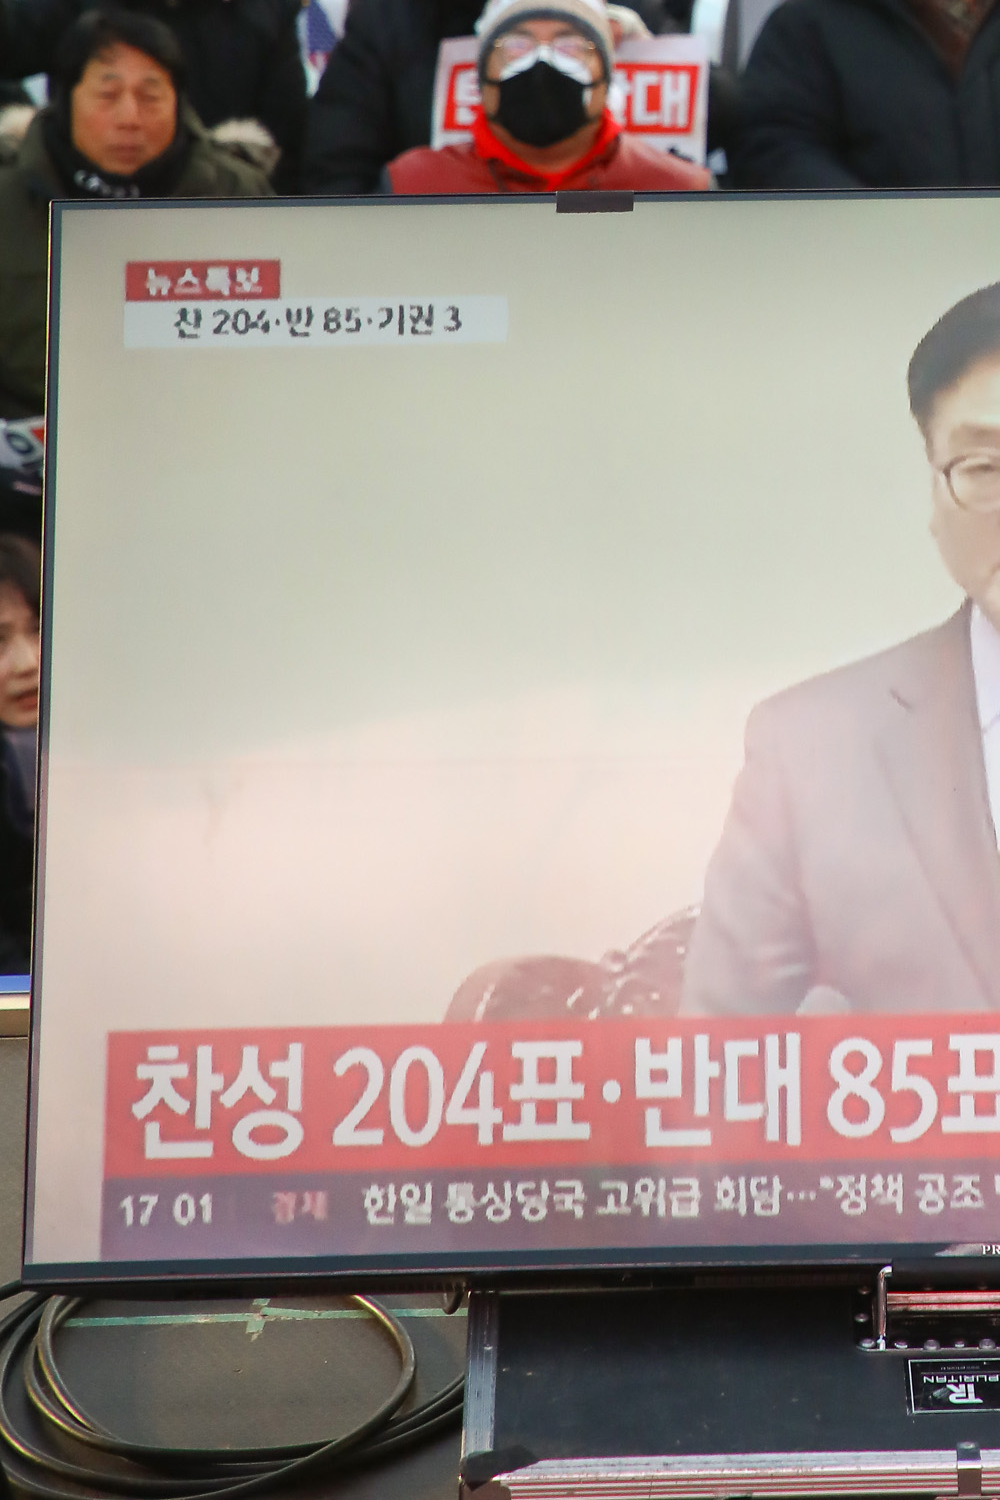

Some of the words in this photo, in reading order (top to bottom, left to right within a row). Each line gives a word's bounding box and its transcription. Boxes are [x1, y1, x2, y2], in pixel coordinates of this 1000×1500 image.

[145, 266, 263, 297] 뉴스특보
[173, 306, 202, 339] 찬
[443, 304, 463, 333] 3
[131, 1042, 305, 1161] 찬성
[120, 1193, 158, 1227] 17
[171, 1192, 214, 1225] 01
[362, 1181, 433, 1226] 한일
[445, 1178, 586, 1225] 통상당국
[597, 1176, 701, 1218] 고위급
[917, 1171, 985, 1215] 공조
[923, 1374, 1000, 1384] PURITAN
